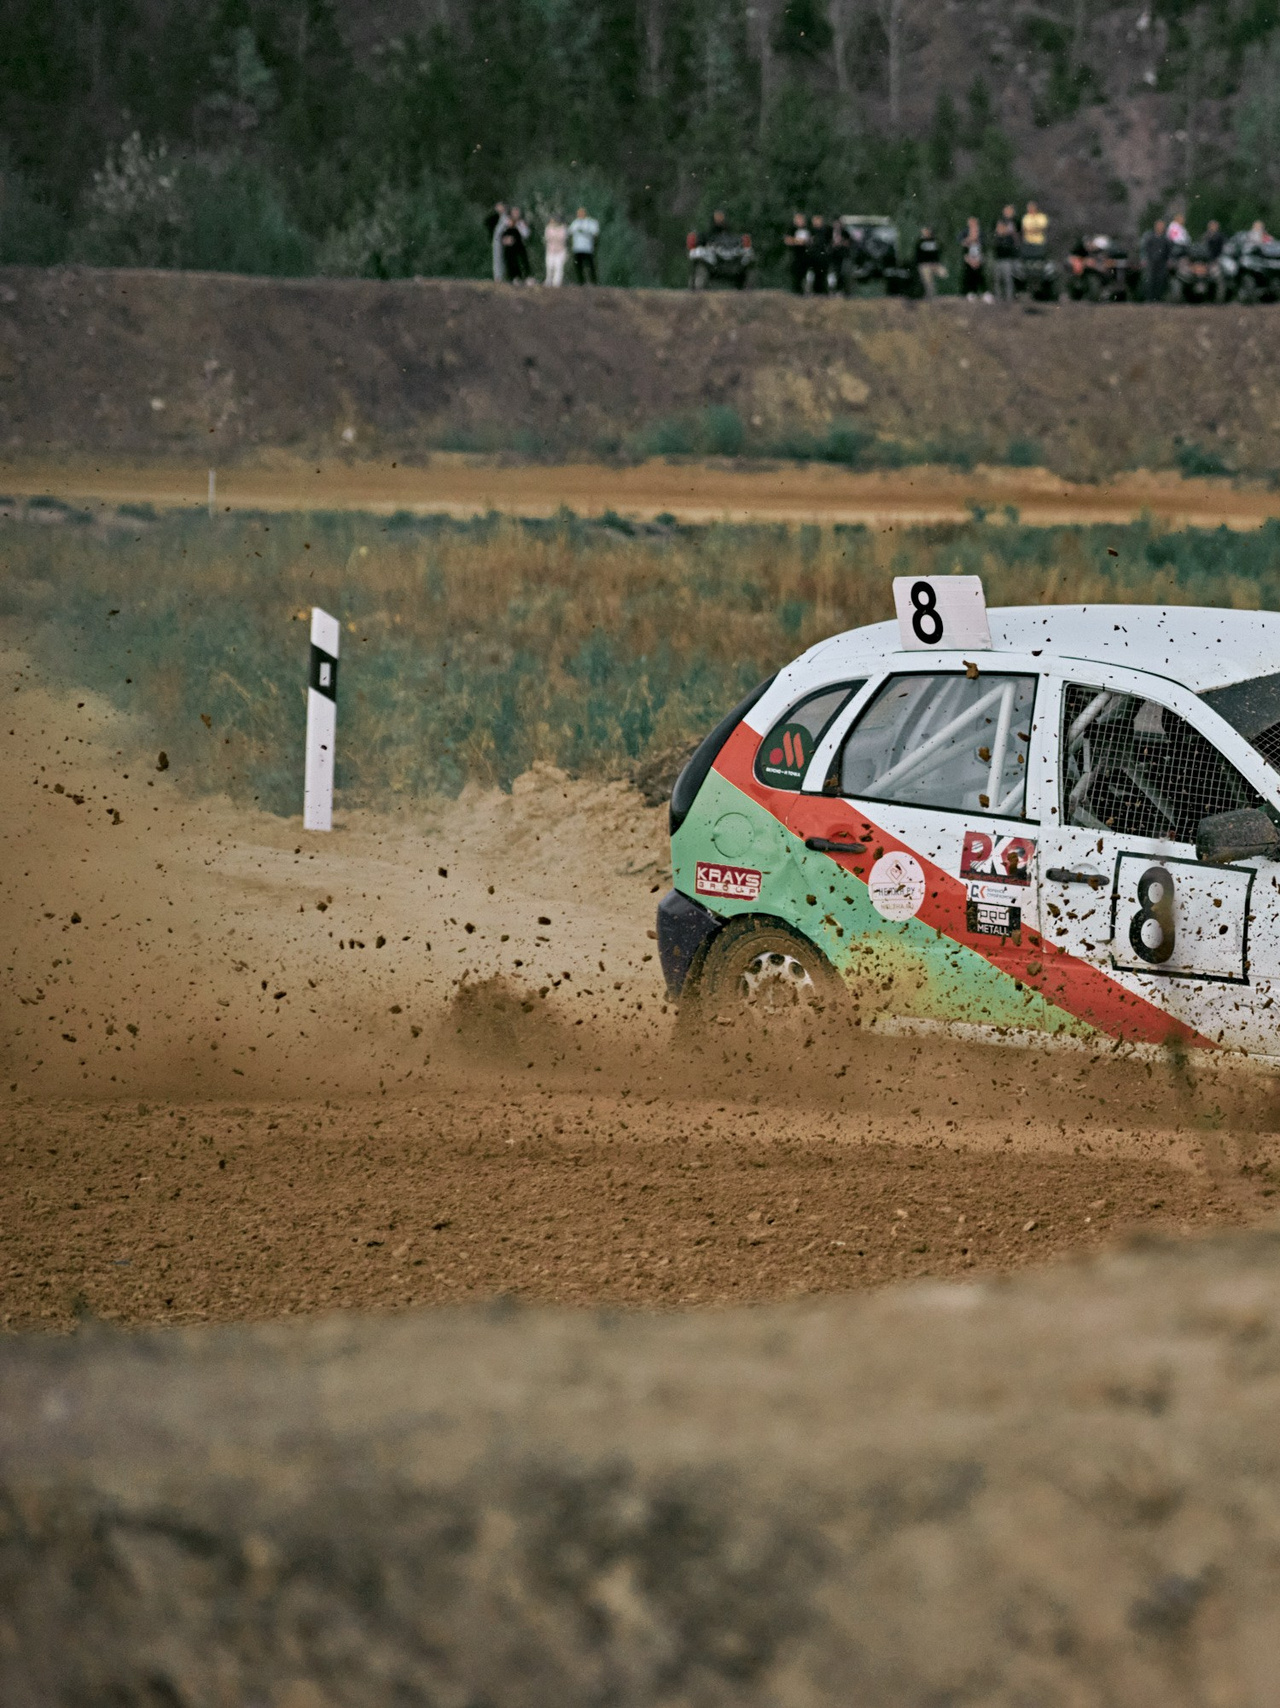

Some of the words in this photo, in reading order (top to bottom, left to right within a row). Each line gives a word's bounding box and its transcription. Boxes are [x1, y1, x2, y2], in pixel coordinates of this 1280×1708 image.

[910, 580, 944, 645] 8
[697, 866, 760, 888] KRAYS
[698, 881, 756, 895] GROUP
[1129, 866, 1176, 965] 8
[977, 923, 1009, 936] METALL
